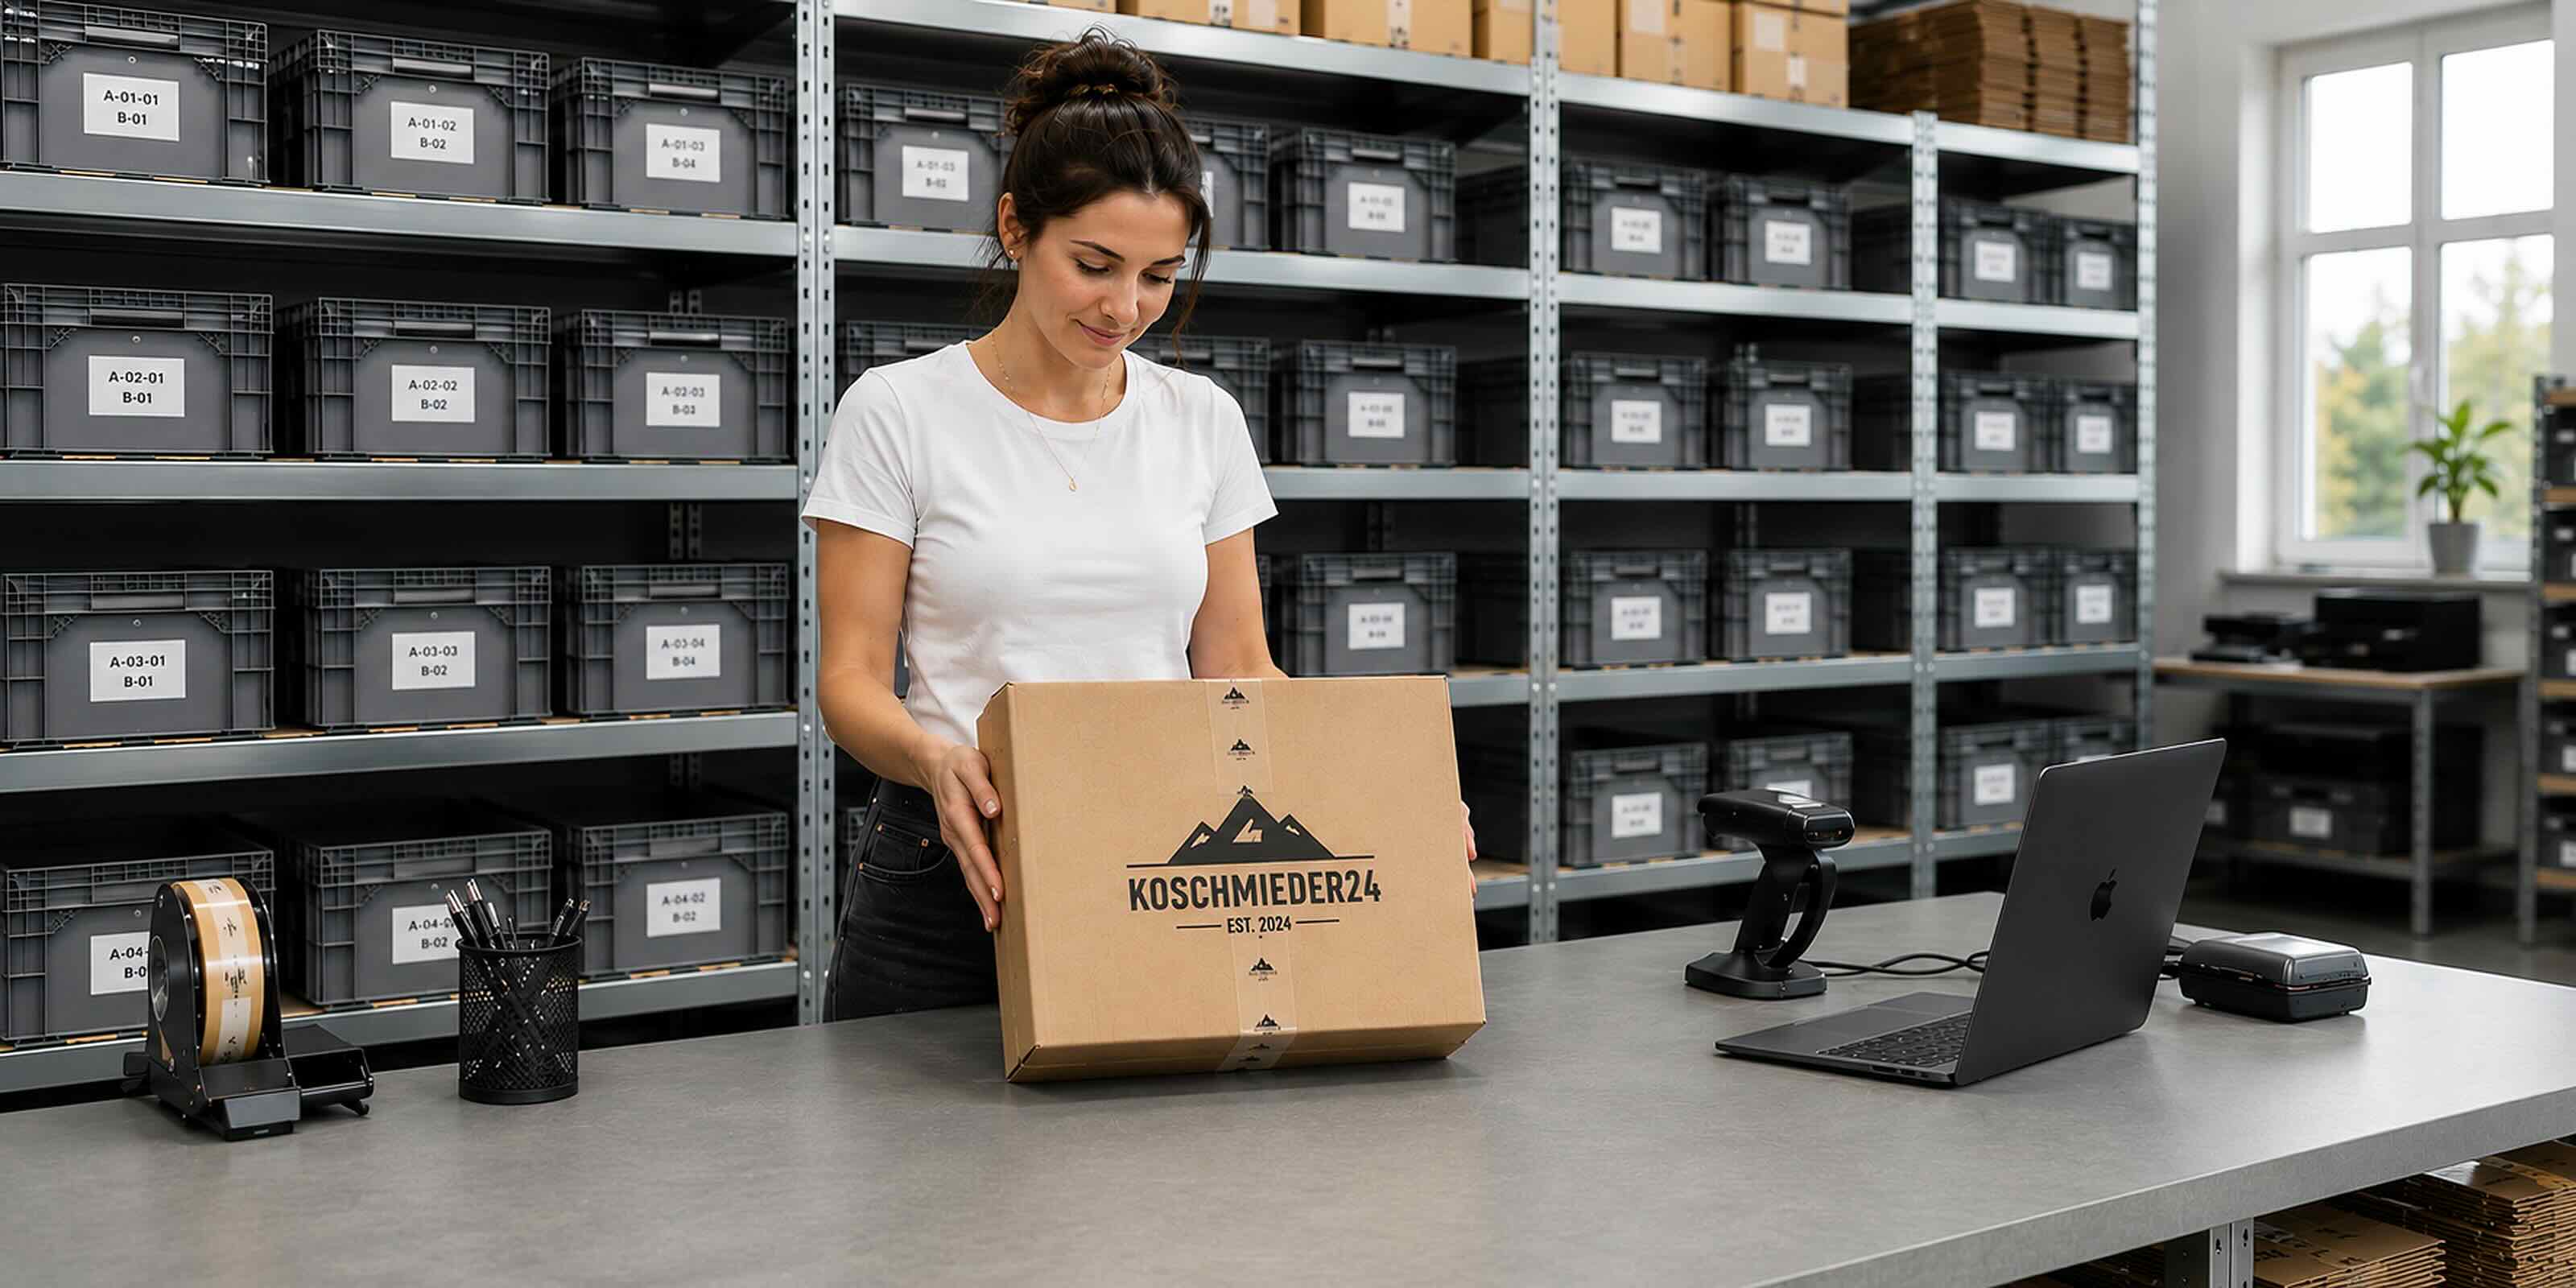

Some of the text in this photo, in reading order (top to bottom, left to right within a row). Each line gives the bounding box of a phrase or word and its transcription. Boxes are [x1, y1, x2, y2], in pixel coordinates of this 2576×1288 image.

[104, 90, 158, 105] A-01-01
[118, 112, 146, 125] B-01
[408, 118, 456, 131] A-01-02
[420, 138, 447, 150] B-02
[662, 138, 705, 151] A-01-03
[109, 371, 163, 383] A-02-01
[409, 379, 457, 391] A-02-02
[123, 391, 151, 404] B-01
[421, 398, 448, 410] B-02
[409, 645, 457, 658] A-03-03
[109, 654, 164, 668] A-03-01
[421, 664, 448, 677] B-02
[124, 675, 152, 688] B-01
[1128, 869, 1381, 911] KOSCHMIEDER24
[1227, 915, 1292, 934] EST. 2024
[421, 936, 448, 949] B-02
[109, 946, 148, 960] A-04-
[124, 965, 147, 979] B-0
